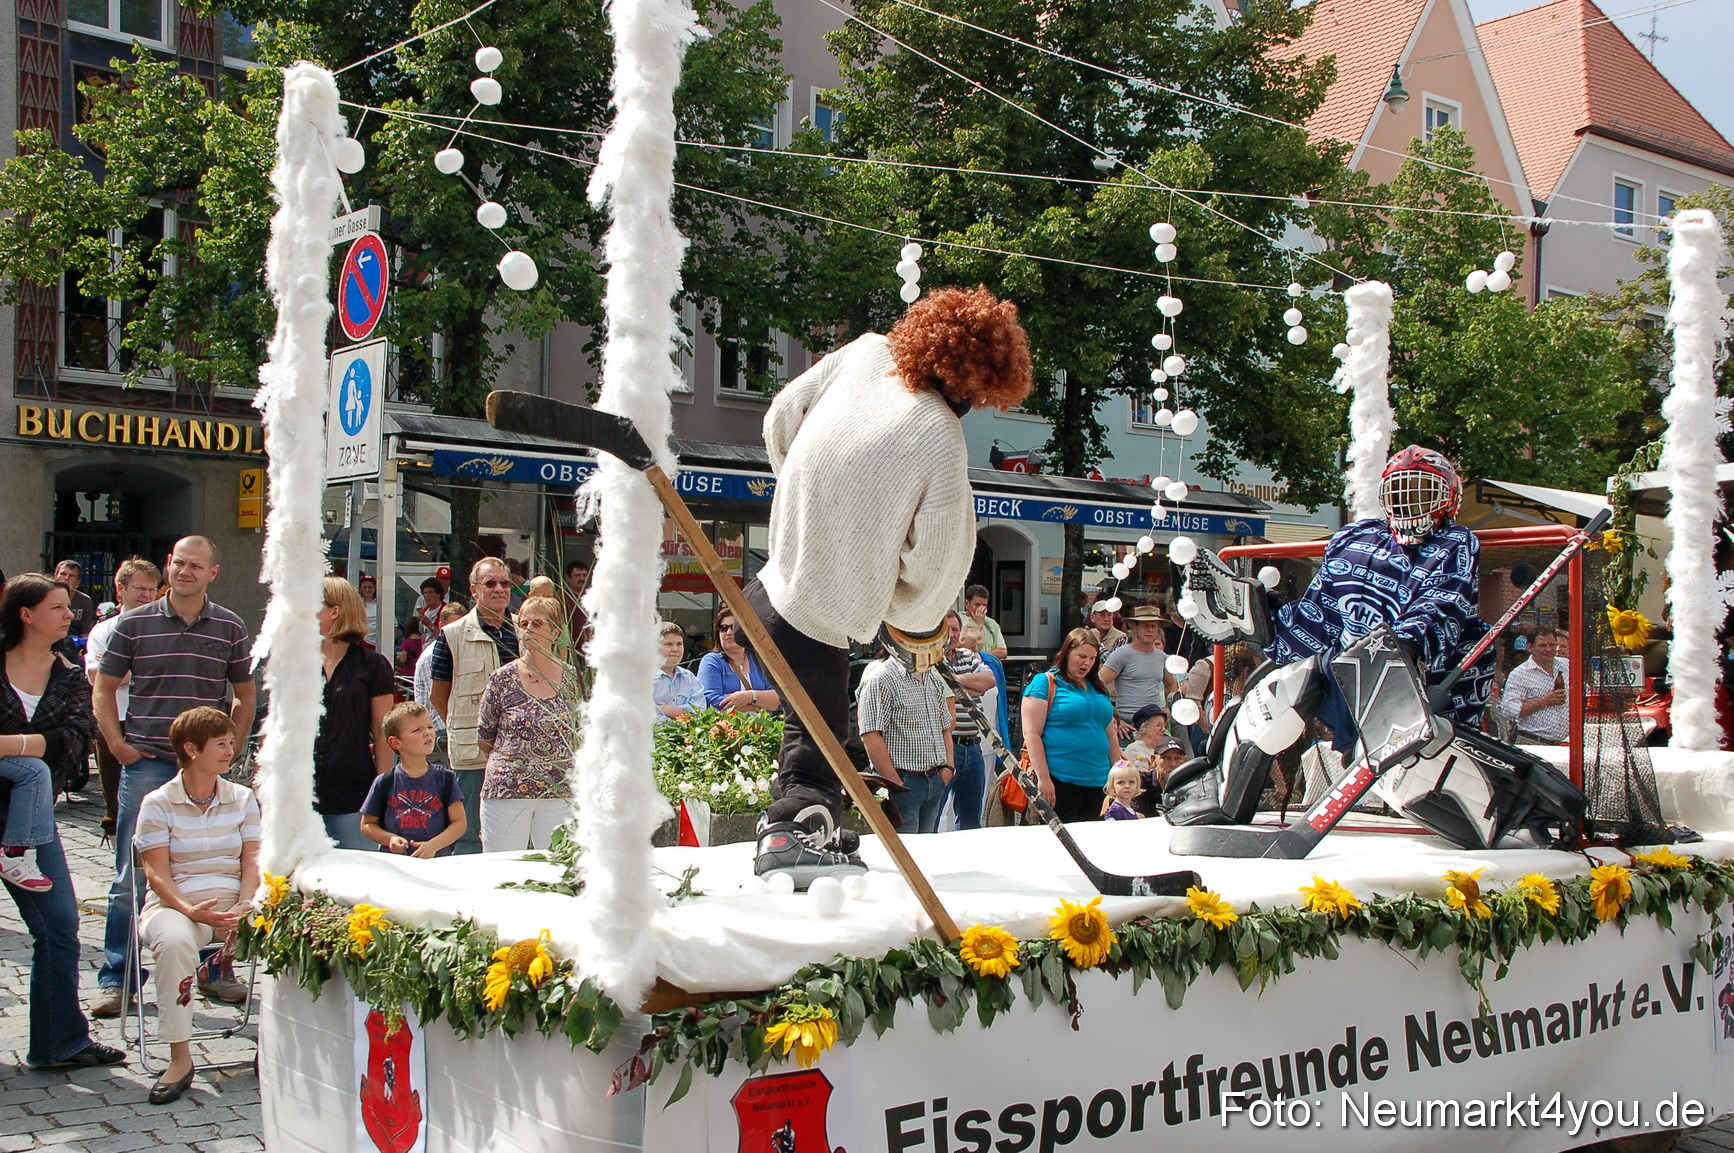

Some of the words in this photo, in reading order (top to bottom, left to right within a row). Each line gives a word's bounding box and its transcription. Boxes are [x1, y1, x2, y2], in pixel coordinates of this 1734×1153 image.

[347, 218, 367, 234] Gasse
[338, 443, 367, 467] ZONE
[540, 463, 600, 482] OBS
[974, 497, 1022, 518] BECK
[1094, 509, 1134, 525] OBST
[1151, 513, 1209, 531] GEMÜSE
[1519, 539, 1580, 599] TITAN
[1292, 627, 1323, 651] HOCKEY
[1455, 739, 1516, 773] EACTOR
[884, 1025, 1390, 1153] Eissportfreunde
[1403, 978, 1626, 1072] Neumarkt
[1630, 962, 1705, 1020] e.V.
[748, 1079, 817, 1097] Eissportfreunde
[752, 1099, 796, 1112] Neumarkt
